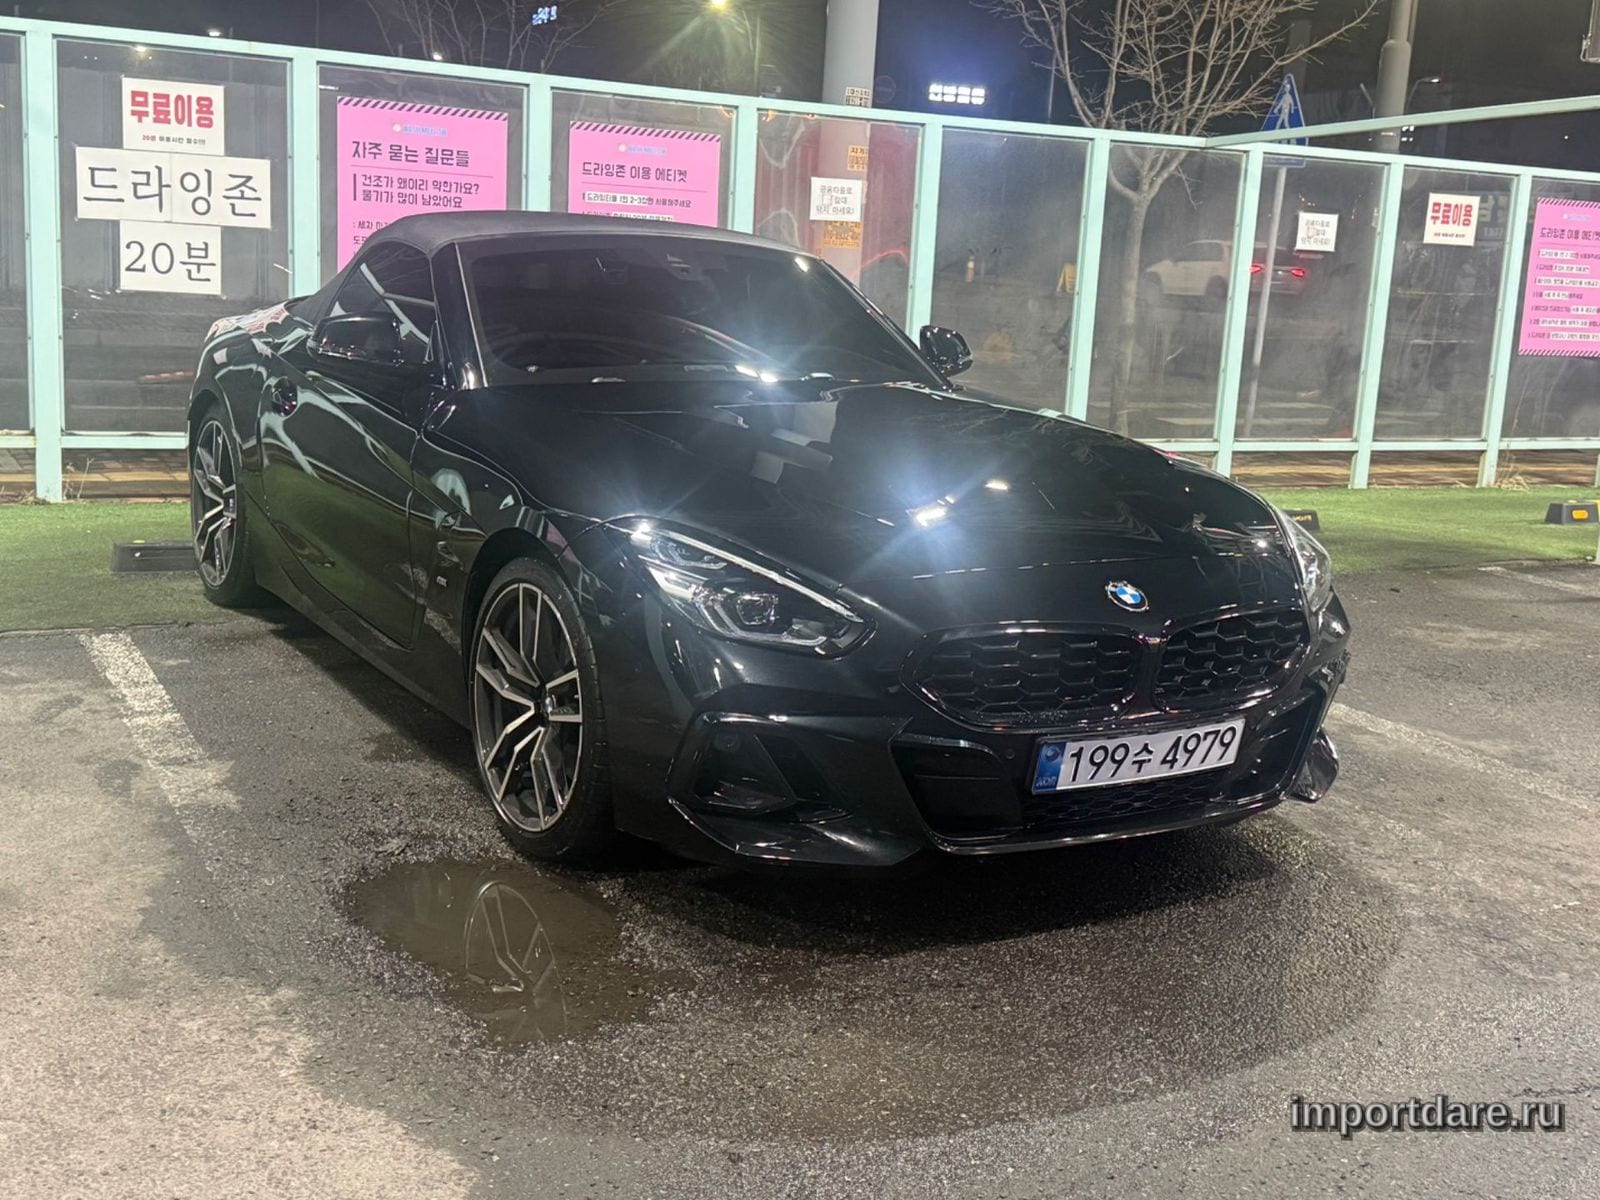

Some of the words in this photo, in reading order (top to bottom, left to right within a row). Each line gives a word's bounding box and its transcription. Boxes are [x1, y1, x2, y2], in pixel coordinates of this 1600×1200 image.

[131, 90, 214, 128] 무료이용
[352, 141, 382, 160] 자주
[388, 144, 419, 163] 묻는
[425, 147, 470, 167] 질문들
[361, 174, 394, 189] 건조가
[397, 177, 429, 191] 왜이리
[432, 180, 480, 195] 약한가요?
[582, 162, 626, 178] 드라잉존
[630, 166, 652, 180] 이용
[655, 167, 687, 183] 에티켓
[83, 165, 262, 217] 드라잉존
[362, 189, 394, 203] 물기가
[397, 192, 418, 205] 많이
[421, 194, 463, 208] 남았어요
[1431, 202, 1472, 226] 무료이용
[124, 240, 217, 282] 20분
[1070, 742, 1154, 782] 199수
[1160, 726, 1237, 769] 4979
